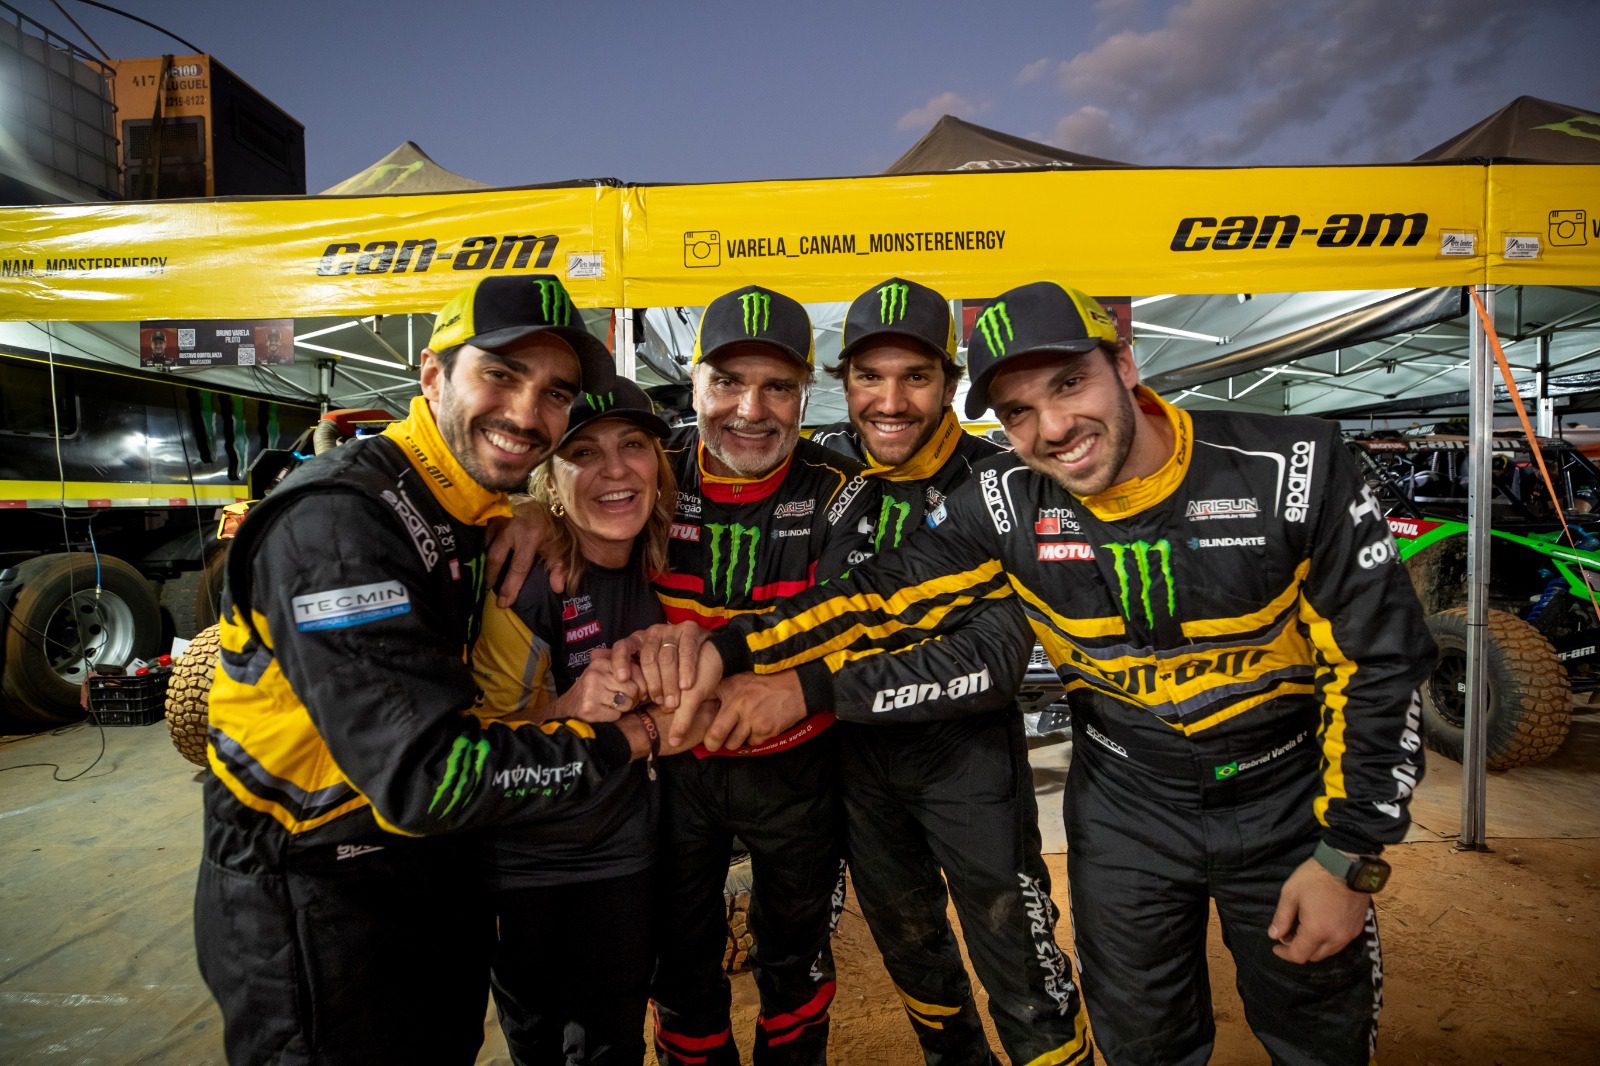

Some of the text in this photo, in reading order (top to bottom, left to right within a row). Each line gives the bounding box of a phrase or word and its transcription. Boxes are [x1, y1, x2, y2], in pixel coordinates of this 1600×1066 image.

[162, 79, 208, 91] LUGUEL
[727, 230, 1006, 258] VARELA_CANAM_MONSTERENERGY
[1170, 213, 1428, 252] can-am
[316, 235, 559, 276] can-am
[1284, 440, 1316, 523] sparco
[827, 475, 868, 526] sparco
[979, 468, 1012, 535] sparco
[1185, 498, 1262, 517] ARISUN
[380, 489, 439, 573] sparco
[669, 525, 700, 541] TUL
[1061, 518, 1080, 532] Fog
[1387, 520, 1418, 536] OTUL
[1199, 536, 1266, 548] BLINDARTE
[297, 587, 406, 615] TECMIN
[566, 622, 600, 642] MOTUL
[1238, 753, 1271, 771] Gabriel
[1272, 740, 1297, 758] Varela
[1018, 872, 1050, 938] RALLY
